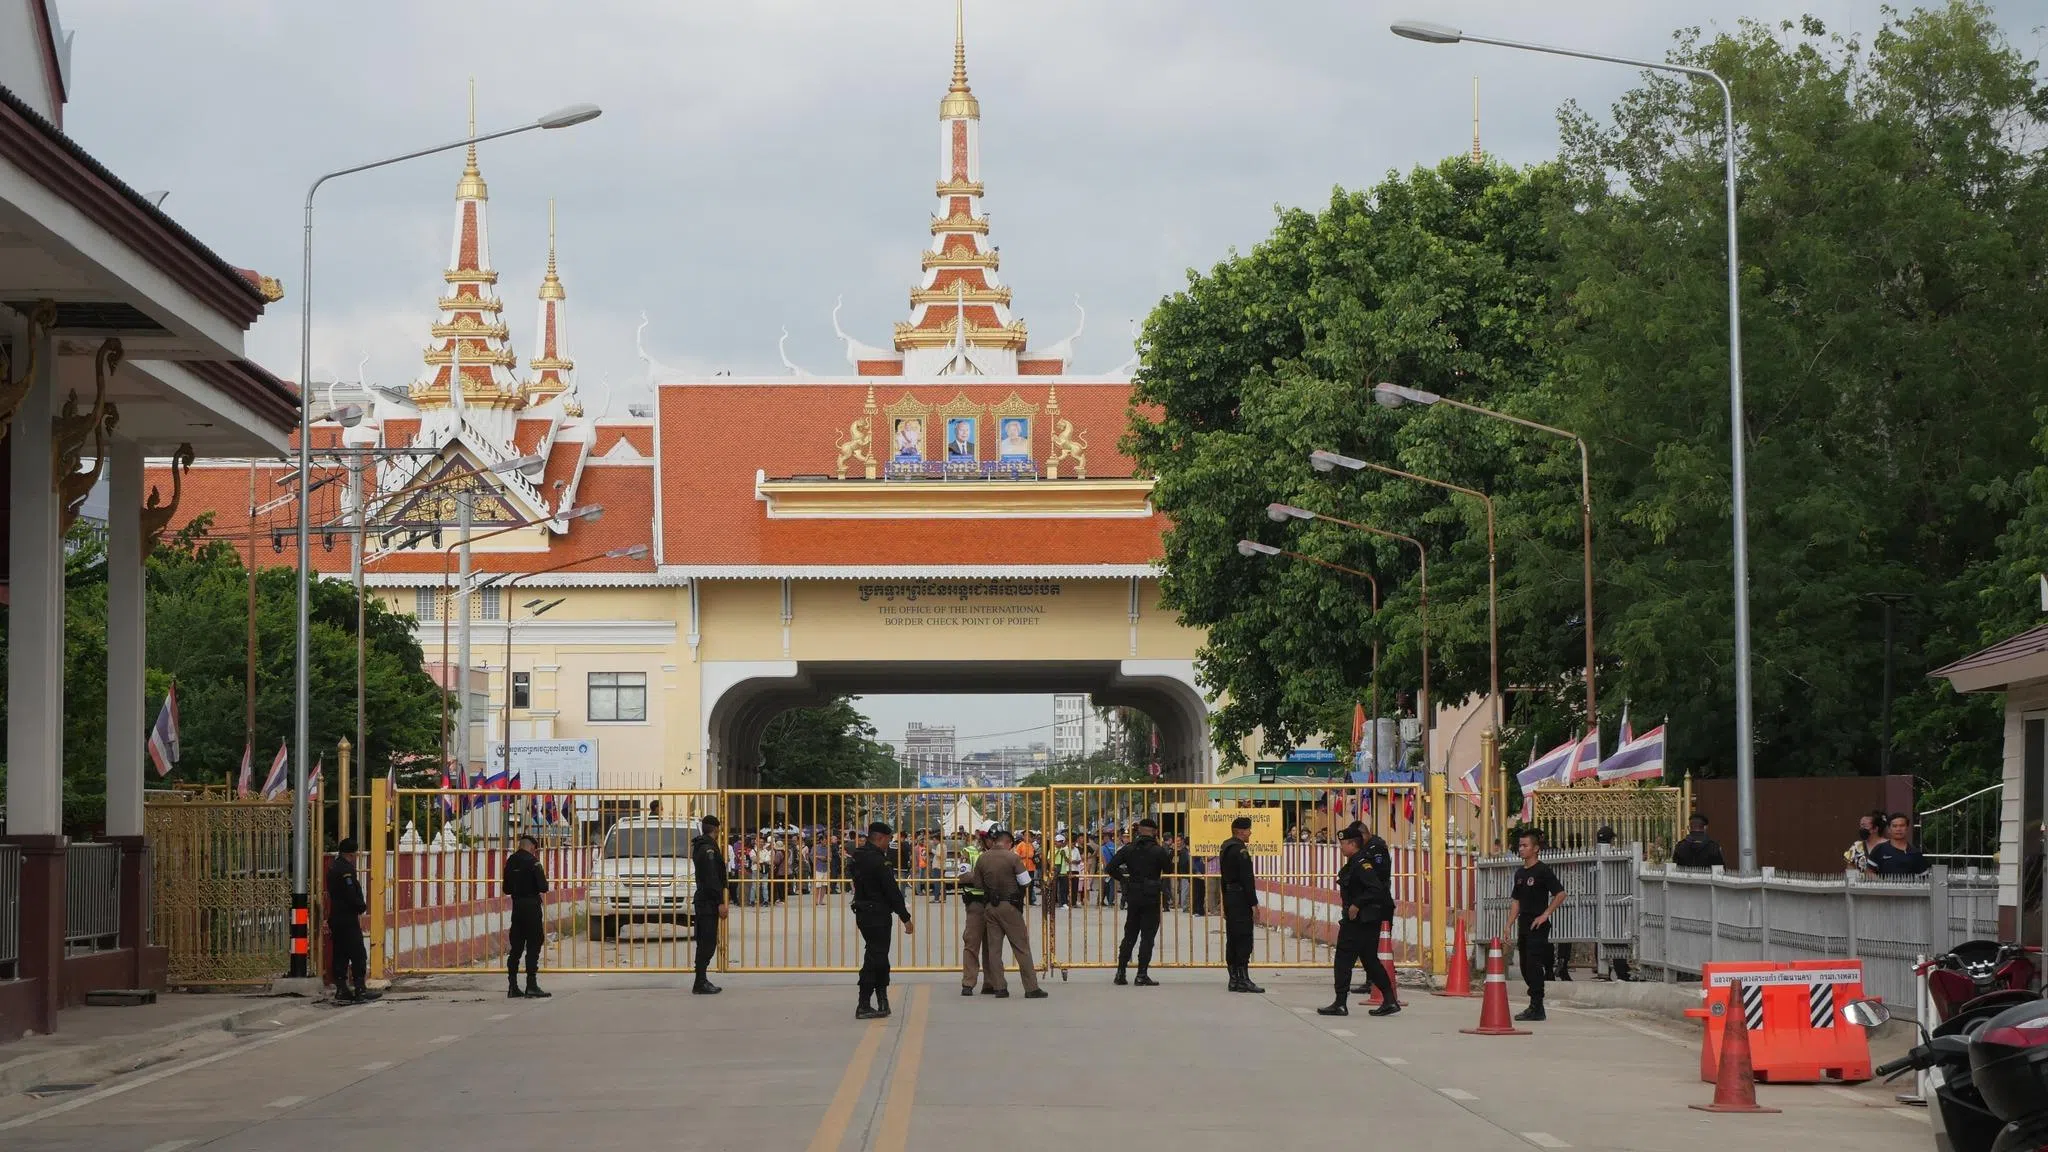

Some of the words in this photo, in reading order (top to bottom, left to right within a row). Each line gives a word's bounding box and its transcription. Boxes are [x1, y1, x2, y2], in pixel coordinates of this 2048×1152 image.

[879, 606, 897, 614] THE
[899, 606, 931, 614] OFFICE
[934, 606, 946, 614] OF
[949, 606, 967, 614] THE
[969, 606, 1046, 614] INTERNATIONAL
[885, 618, 923, 626] BORDER
[926, 618, 959, 626] CHECK
[962, 618, 989, 626] POINT
[992, 618, 1005, 626] OF
[1008, 618, 1040, 626] POIPET
